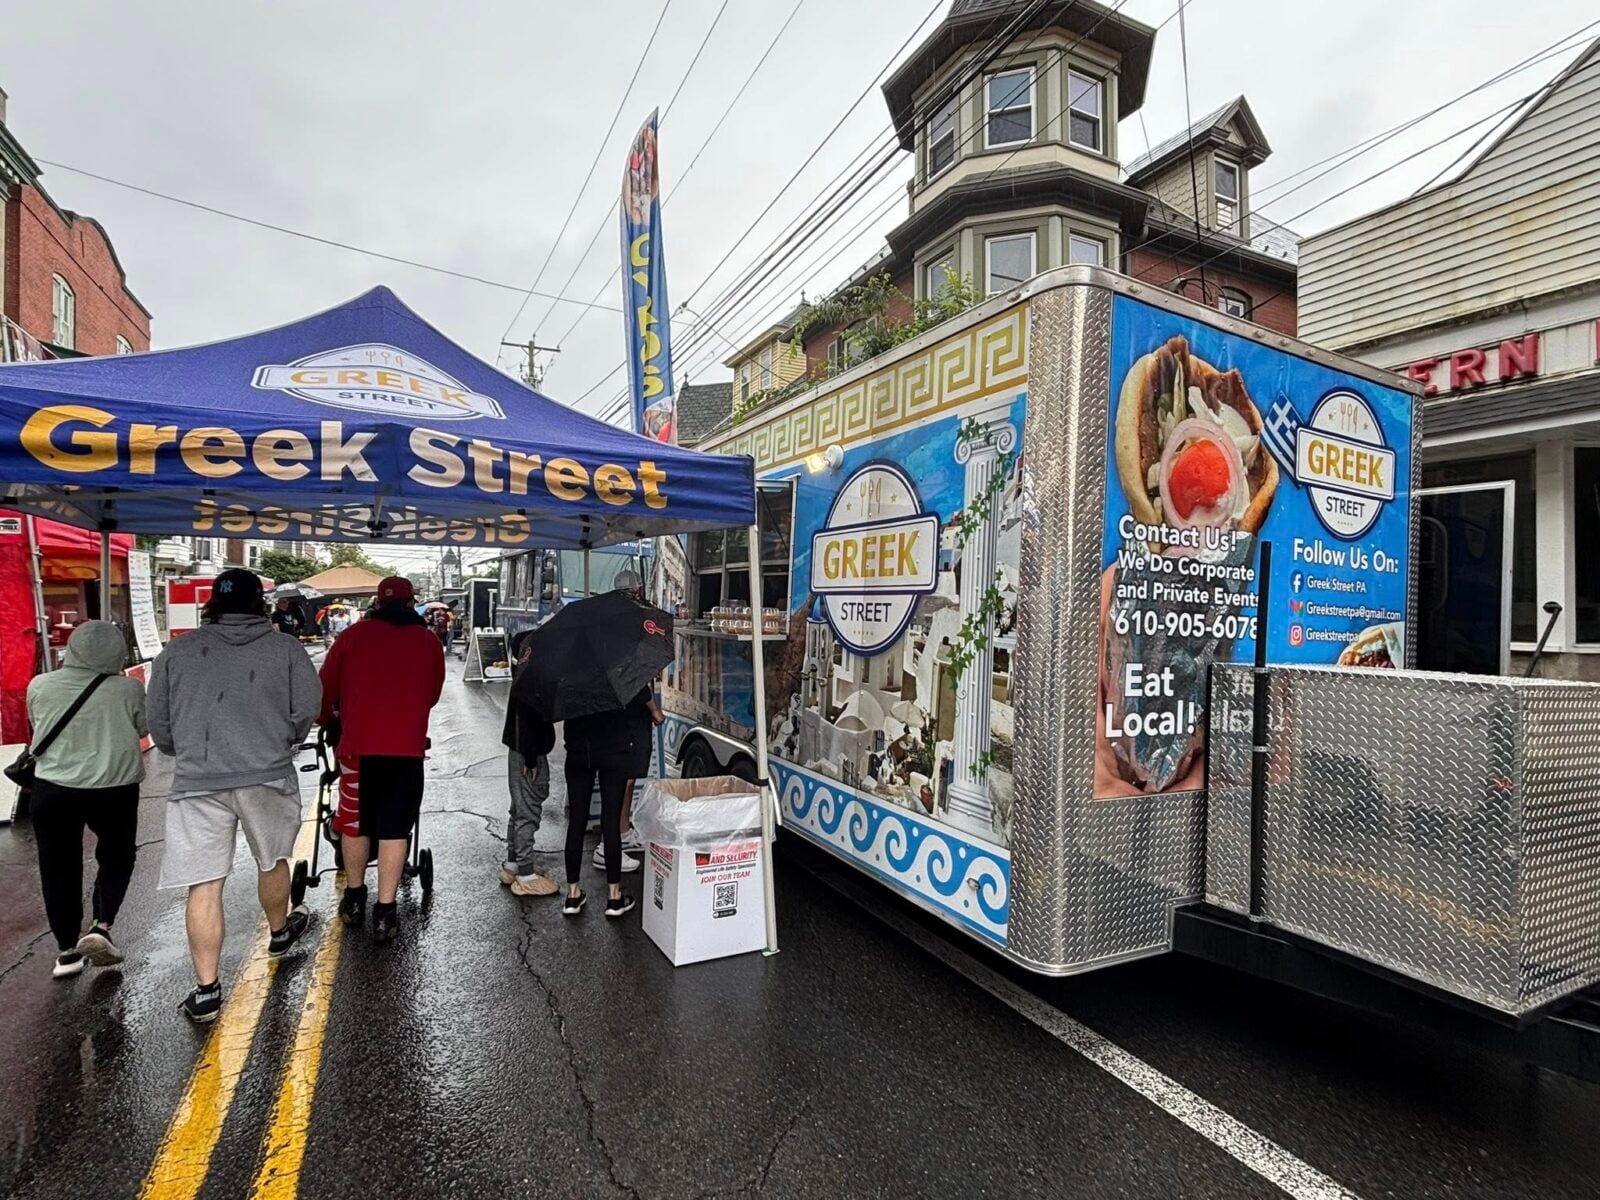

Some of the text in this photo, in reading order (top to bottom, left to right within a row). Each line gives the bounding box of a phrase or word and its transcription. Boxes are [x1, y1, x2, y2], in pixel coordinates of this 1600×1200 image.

[290, 370, 472, 407] GREEK
[338, 391, 437, 410] STREET
[19, 404, 380, 482] Greek
[406, 427, 668, 509] Street
[1307, 440, 1385, 488] GREEK
[1326, 496, 1366, 518] STREET
[1118, 514, 1236, 552] Contact Us!
[823, 530, 920, 581] GREEK
[1118, 550, 1255, 582] We Do Corporate
[1293, 538, 1399, 573] Follow Us On:
[1116, 581, 1259, 607] and Private Events
[1307, 575, 1331, 589] Greek
[1332, 578, 1354, 592] Street
[1356, 581, 1367, 593] PA
[840, 602, 892, 624] STREET
[1115, 609, 1258, 639] 610-905-6078
[1306, 601, 1400, 621] Greekstreetpa@gmail.com
[1305, 627, 1360, 643] Greekstreetpa
[1124, 662, 1174, 698] Eat
[1105, 700, 1196, 738] Local!
[711, 855, 725, 864] AND
[701, 870, 751, 884] JOIN OUR TEAM
